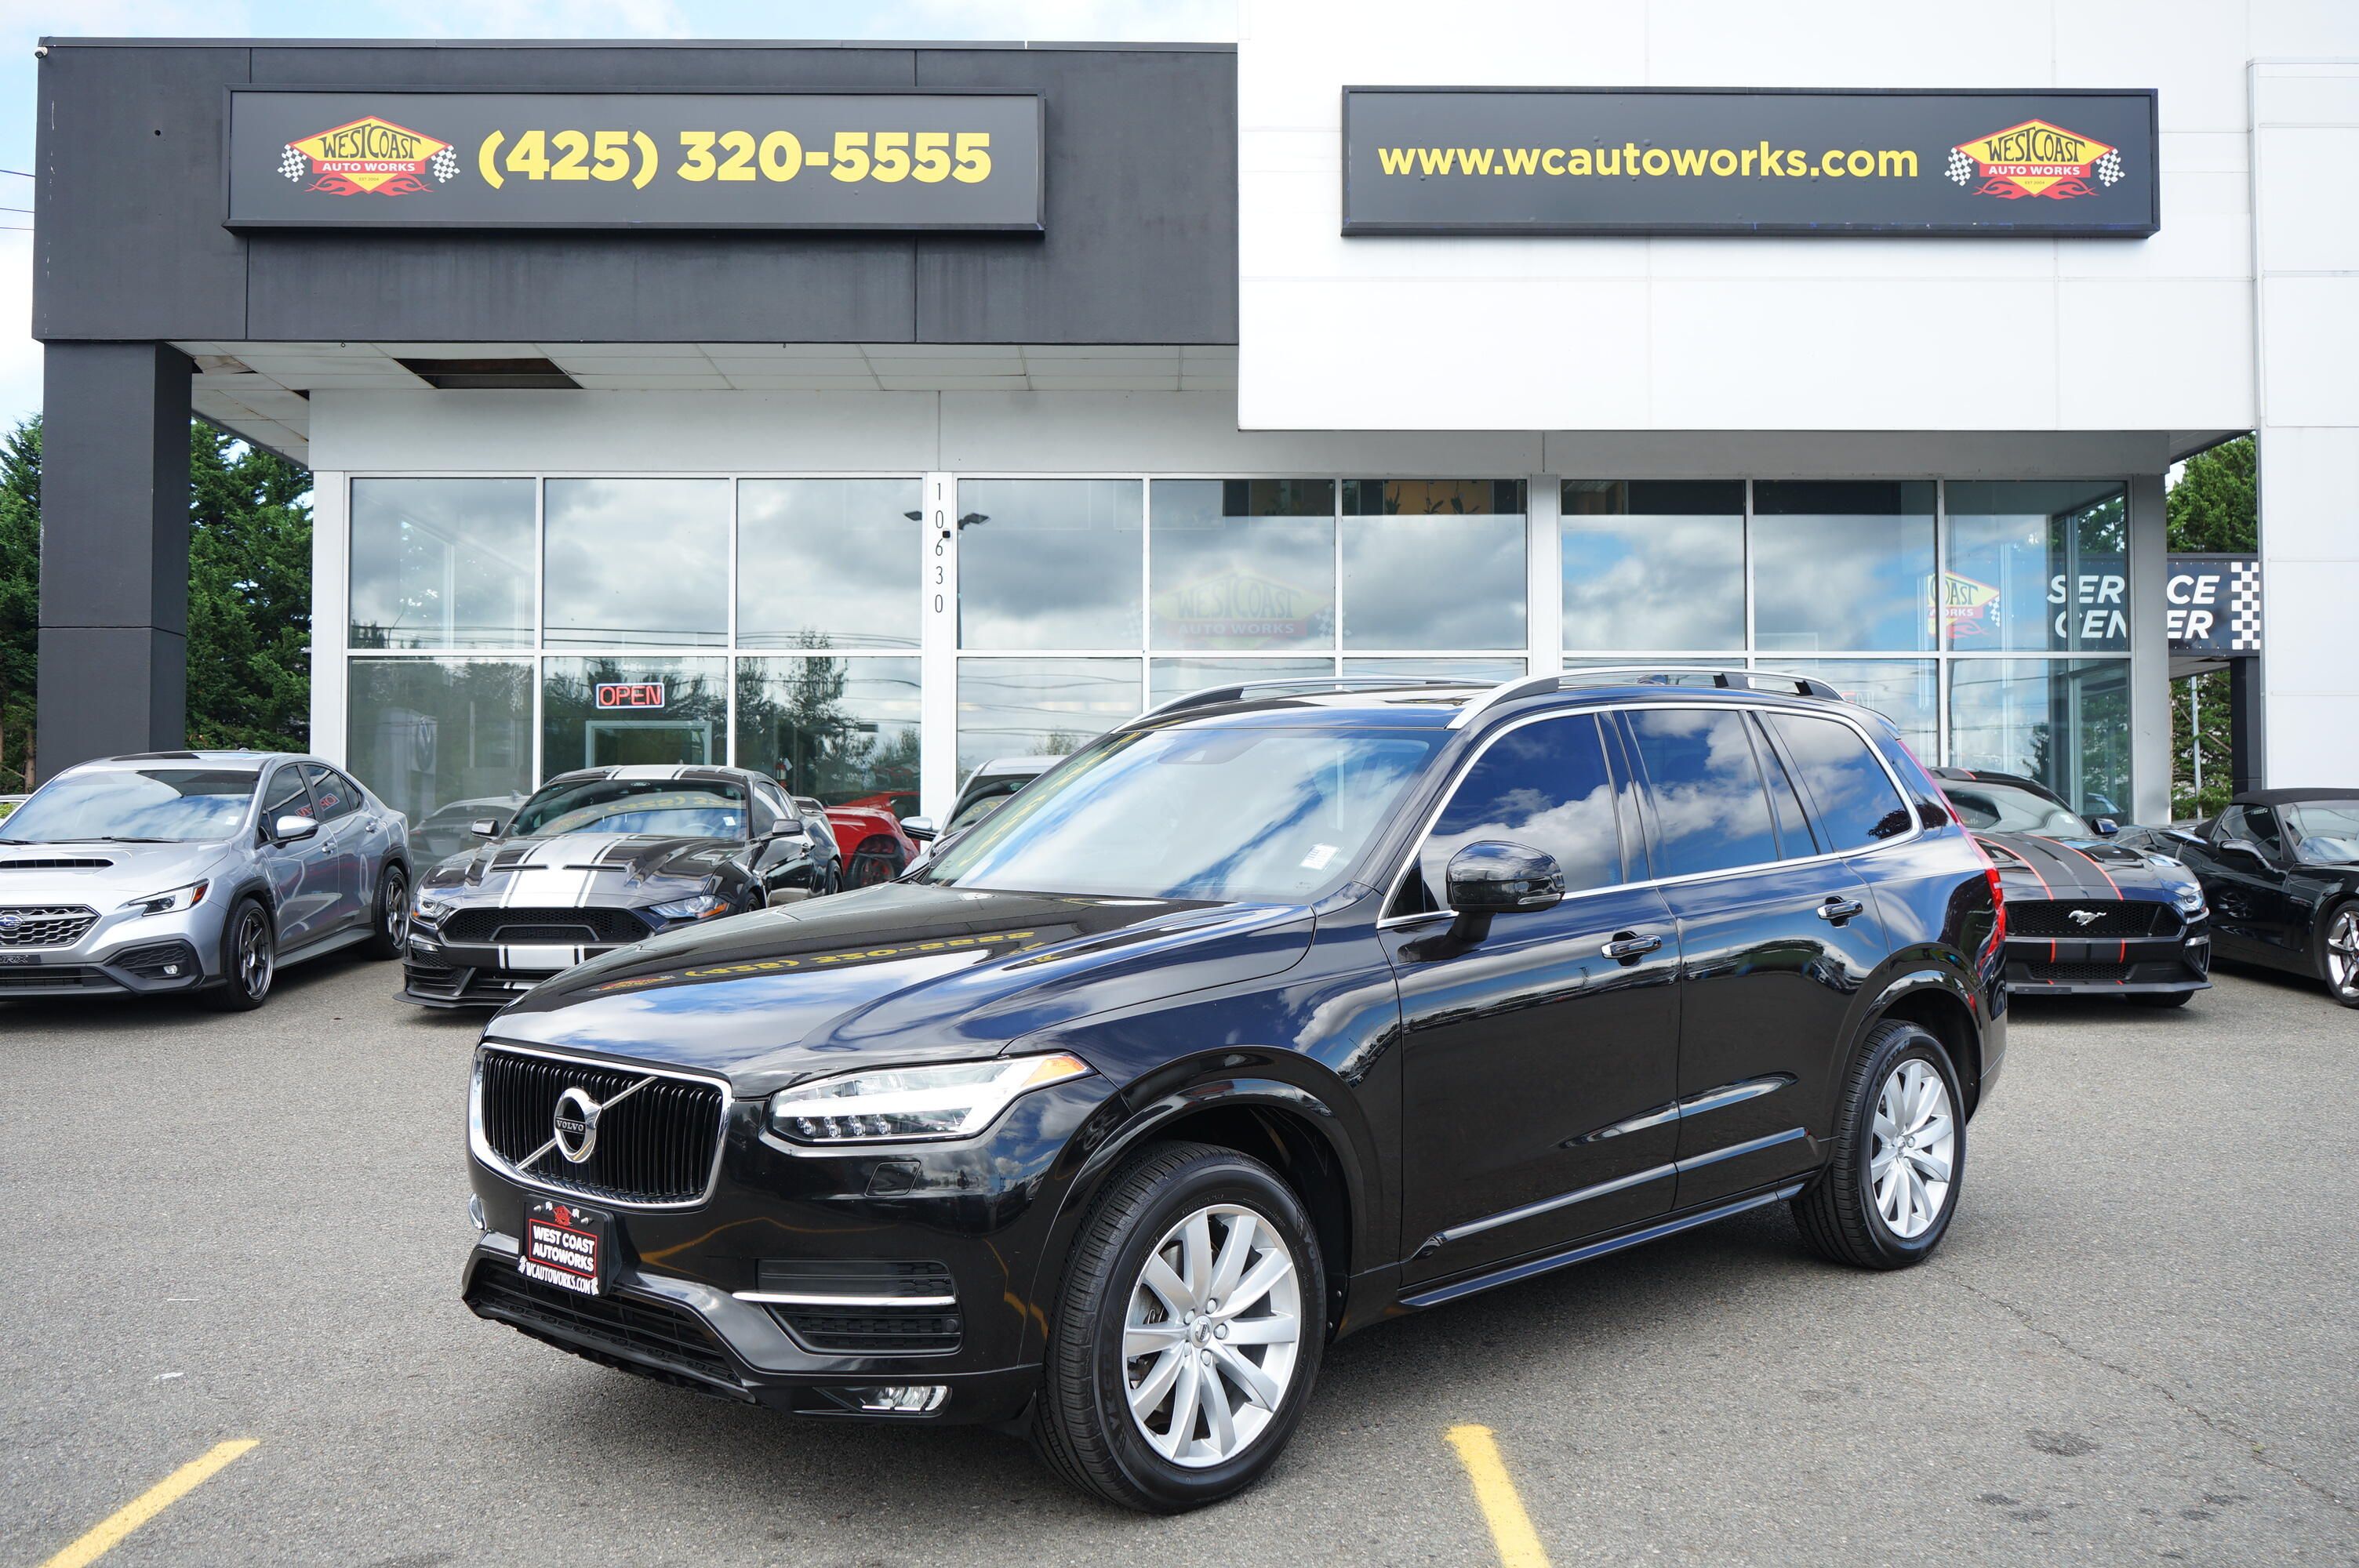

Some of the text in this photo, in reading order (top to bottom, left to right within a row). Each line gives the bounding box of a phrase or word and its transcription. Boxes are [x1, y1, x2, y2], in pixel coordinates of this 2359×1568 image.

[322, 162, 416, 172] AUTO WORKS
[478, 129, 992, 190] (425) 320-5555
[1378, 140, 1918, 178] www.wcautoworks.com
[1988, 165, 2081, 176] AUTO WORKS
[1232, 623, 1294, 634] WORKS
[599, 684, 662, 706] OPEN
[556, 1120, 584, 1132] VOLVO
[533, 1225, 595, 1255] WEST COAST
[532, 1242, 594, 1272] AUTOWORKS
[525, 1261, 592, 1294] WCAUTOWORKS.COM
